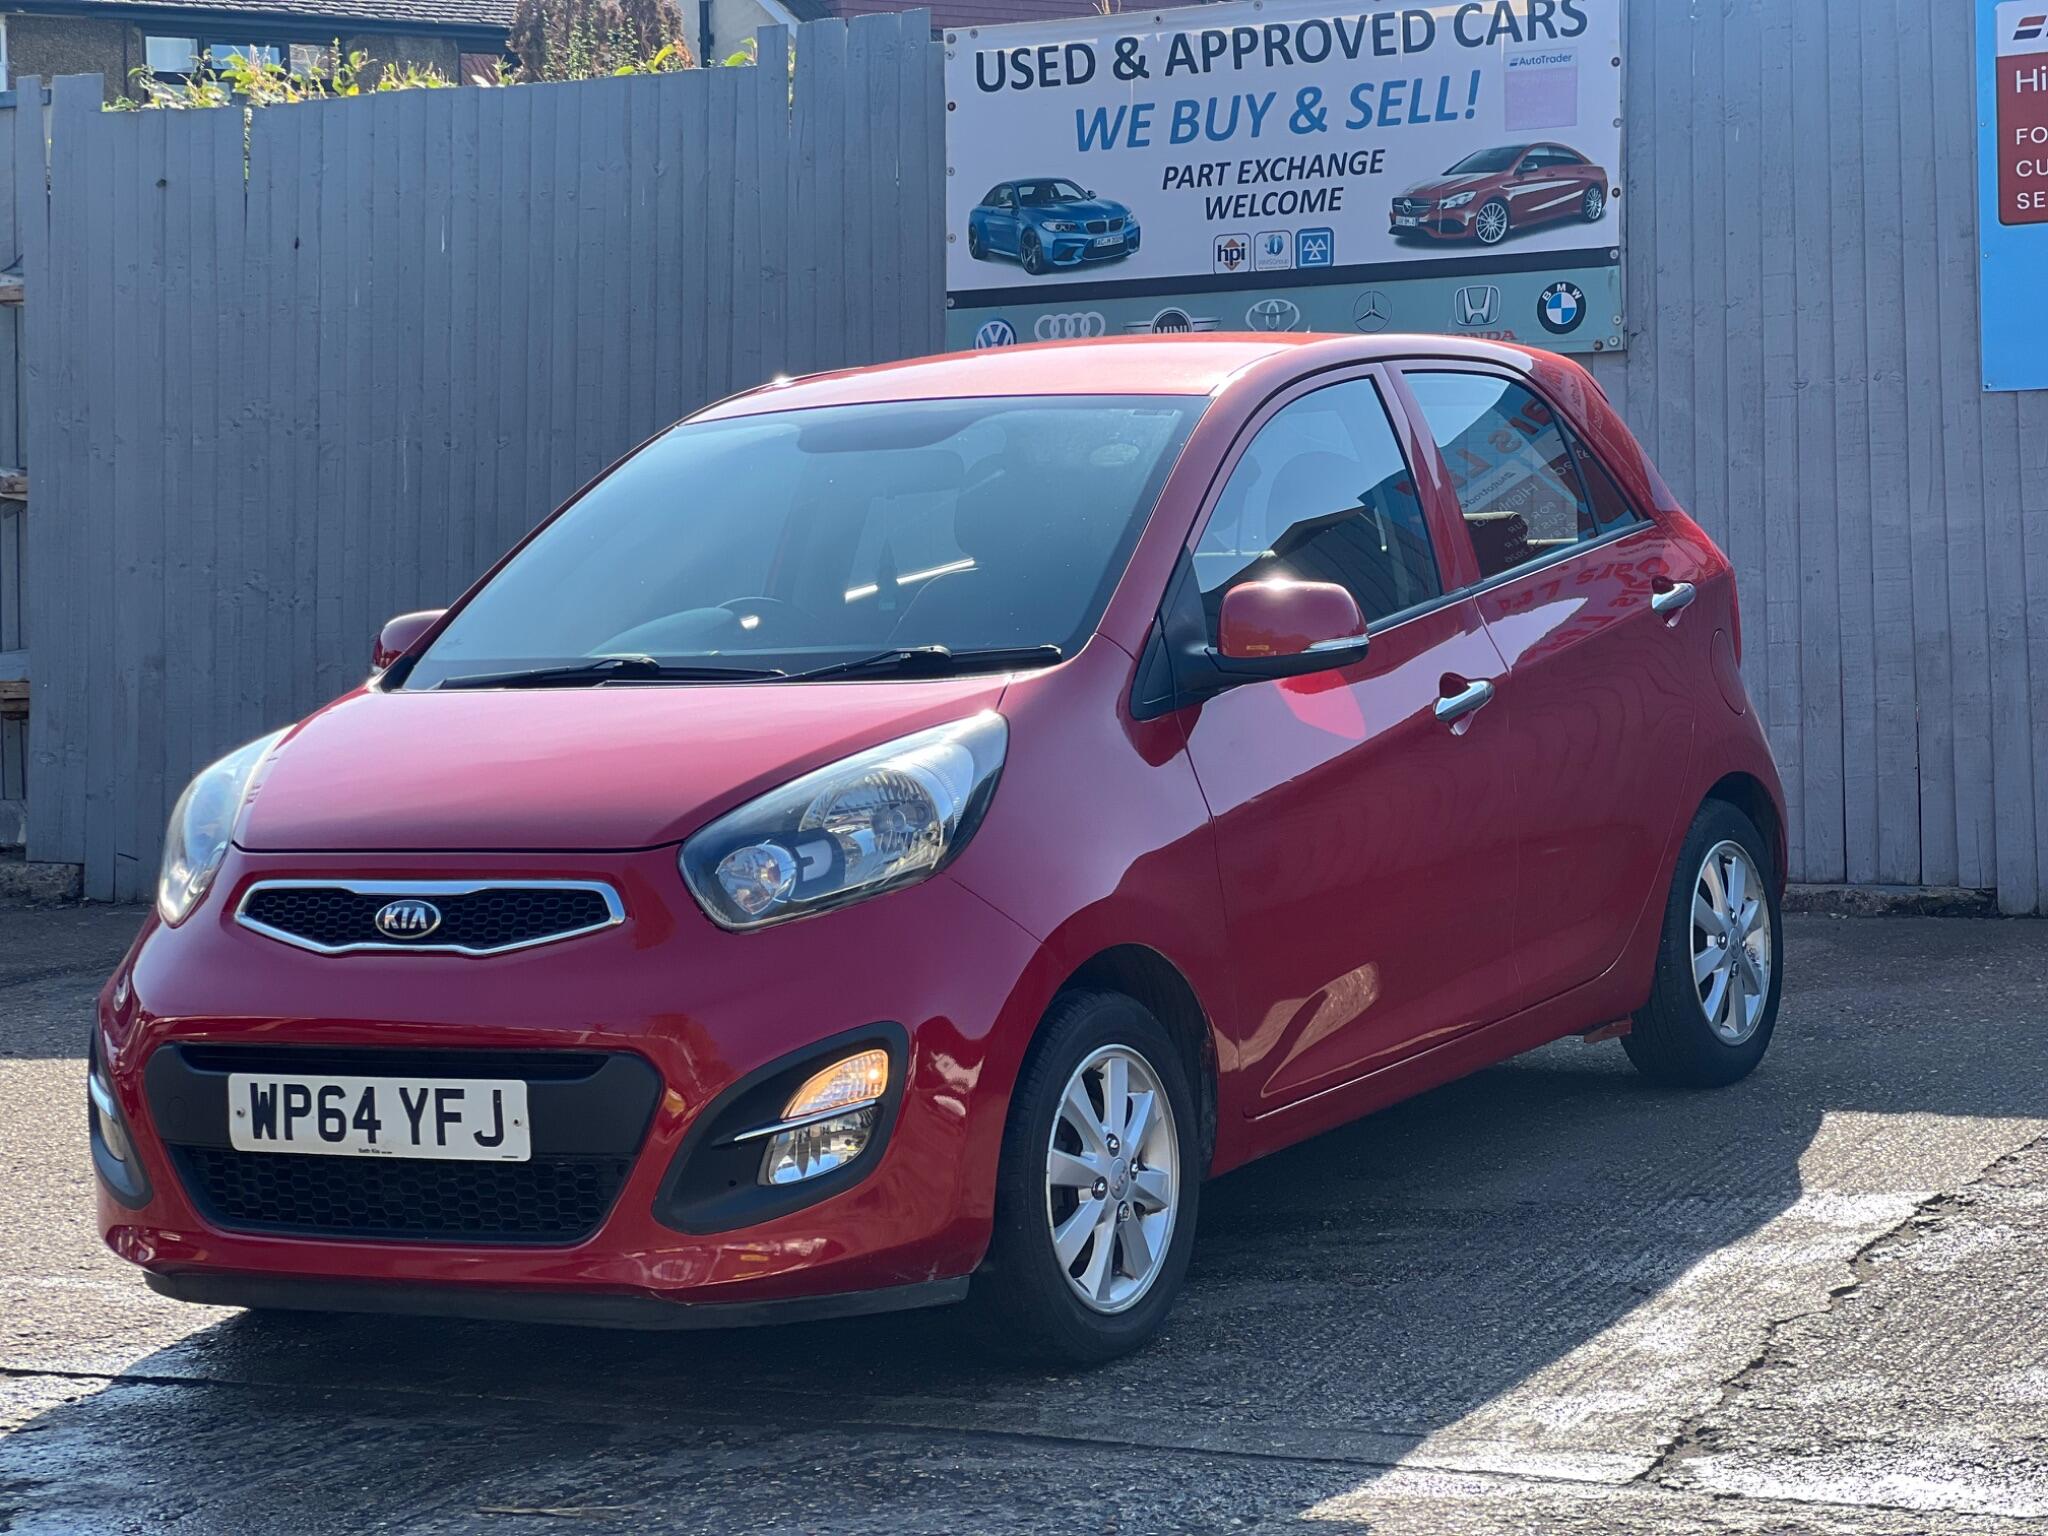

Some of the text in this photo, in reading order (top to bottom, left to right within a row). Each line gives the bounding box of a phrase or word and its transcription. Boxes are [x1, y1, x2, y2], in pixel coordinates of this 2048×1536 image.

[976, 0, 1588, 92] USED & APPROVED CARS
[1519, 54, 1573, 66] AutoTrader
[1075, 103, 1155, 152] WE
[1170, 92, 1277, 145] BUY
[1288, 86, 1328, 135] &
[1345, 70, 1481, 130] SELL!
[1162, 149, 1386, 190] PART EXCHANGE
[1205, 187, 1344, 220] WELCOME
[1217, 242, 1246, 266] hpi
[1542, 283, 1582, 301] BMW
[384, 907, 428, 929] KIA
[250, 1083, 505, 1147] WP64 YFJ
